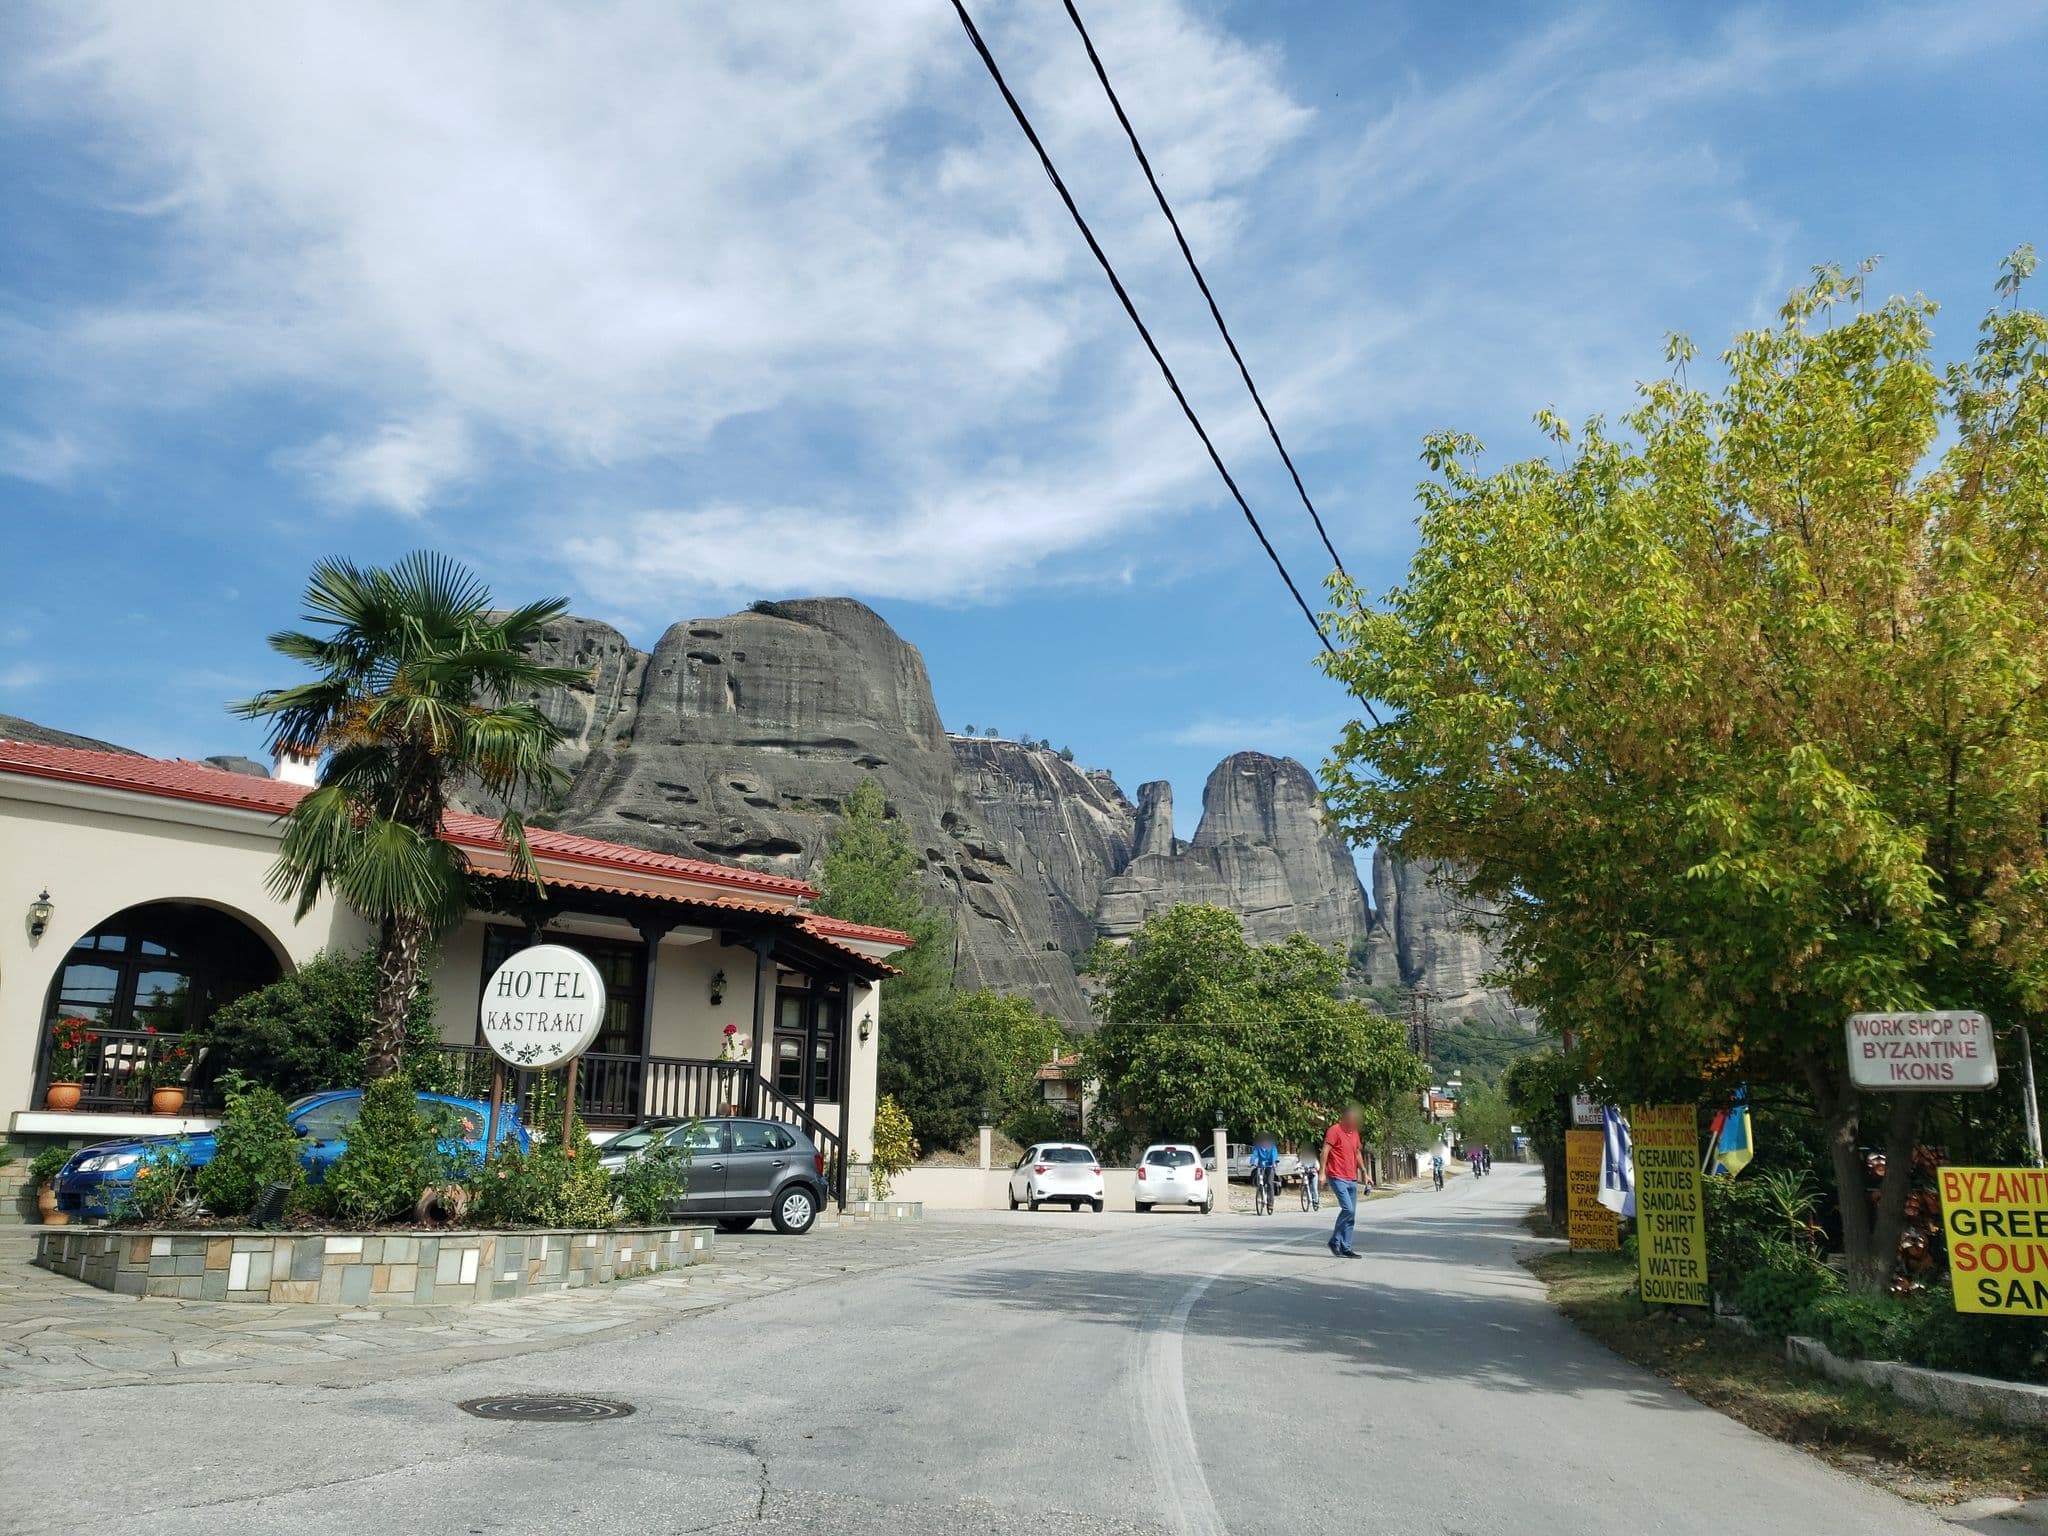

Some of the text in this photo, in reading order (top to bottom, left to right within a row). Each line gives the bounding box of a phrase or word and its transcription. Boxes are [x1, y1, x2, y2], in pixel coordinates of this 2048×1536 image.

[497, 970, 585, 998] HOTEL
[487, 1011, 584, 1032] KASTRAKI
[1854, 1018, 1980, 1036] WORK SHOP OF
[1863, 1041, 1978, 1059] BYZANTINE
[1889, 1063, 1954, 1080] IKONS
[1634, 1128, 1673, 1146] BYZANTINE
[1638, 1150, 1695, 1168] CERAMICS
[1643, 1171, 1693, 1189] STATUES
[1642, 1192, 1696, 1212] SANDALS
[1570, 1209, 1615, 1222] ГРЕЧЕСКОЕ
[1645, 1214, 1695, 1234] T SHIRT
[1950, 1209, 2048, 1238] GREE
[1654, 1236, 1690, 1255] HATS
[1648, 1257, 1699, 1278] WATER
[1977, 1278, 2048, 1310] SAN
